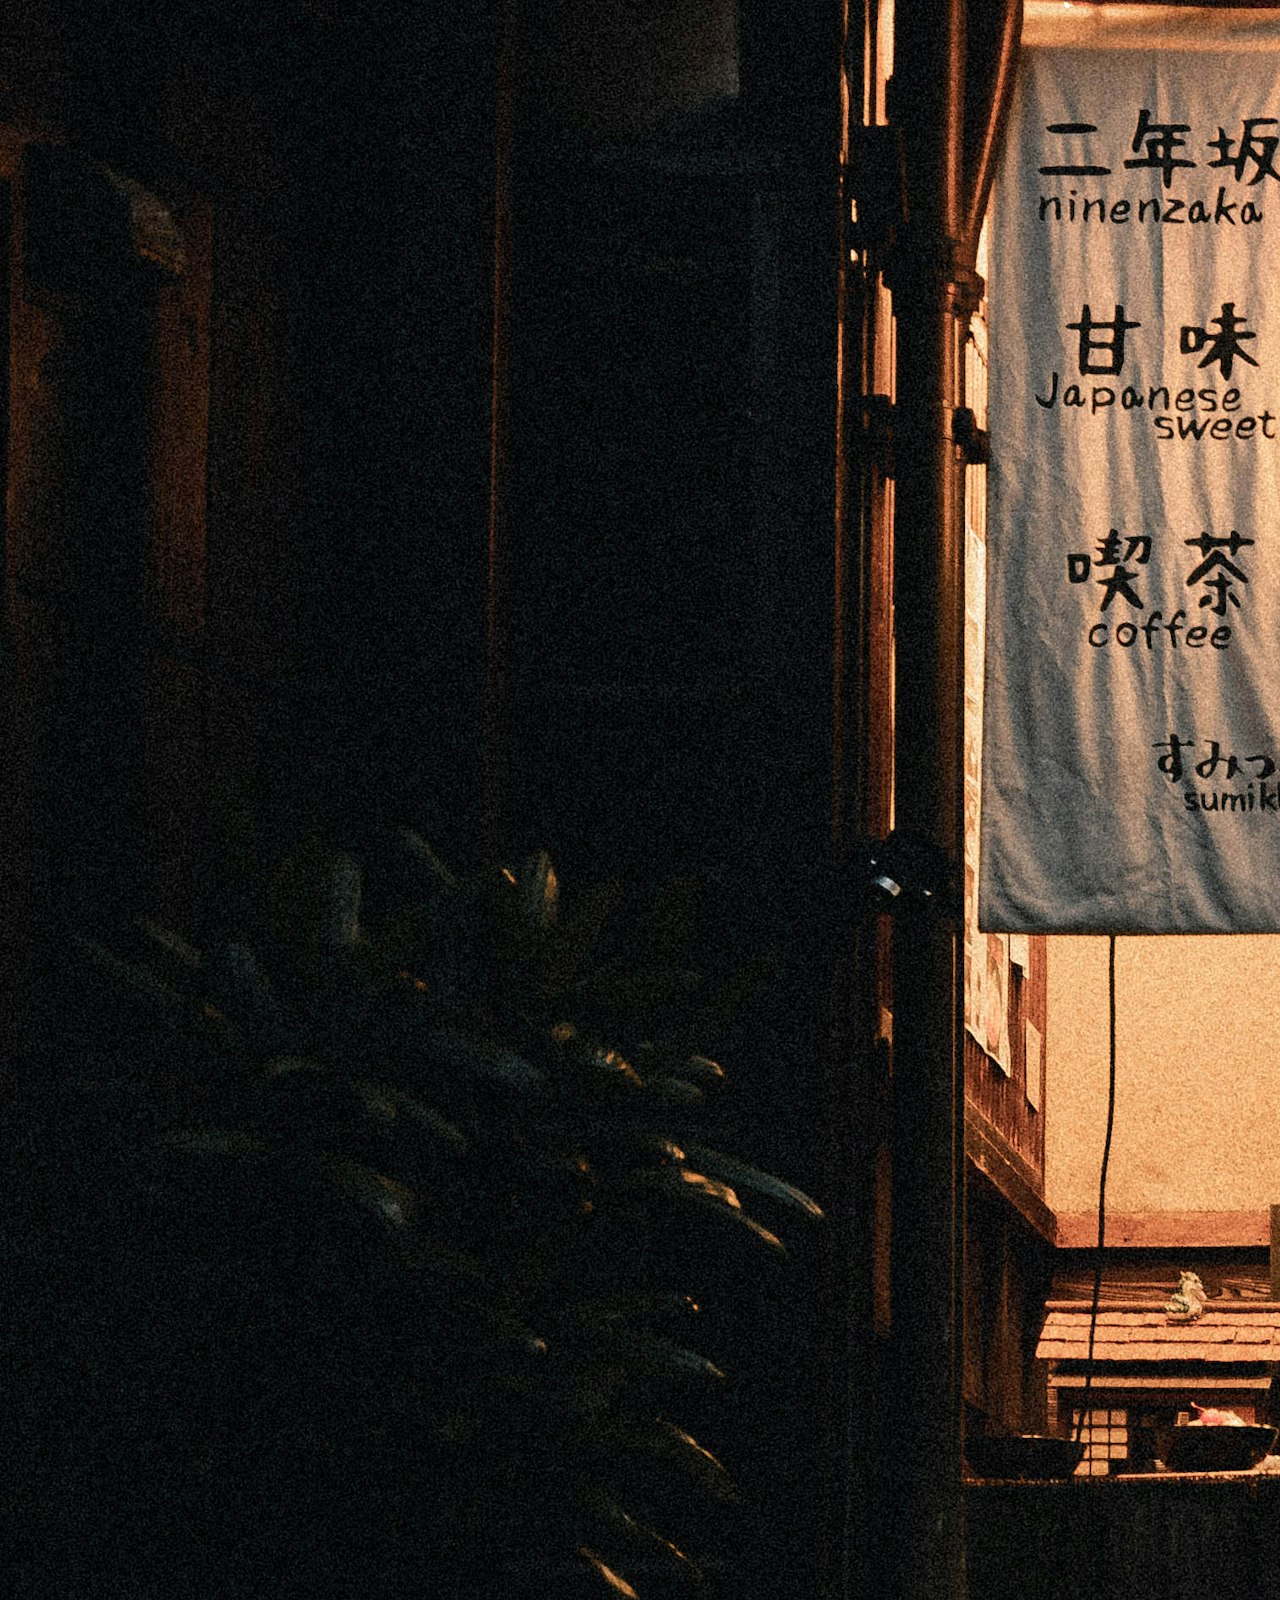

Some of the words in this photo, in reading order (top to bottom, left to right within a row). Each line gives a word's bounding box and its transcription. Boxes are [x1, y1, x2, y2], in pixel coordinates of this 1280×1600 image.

[1039, 189, 1263, 226] ninenzaka
[1066, 302, 1260, 381] 甘味
[1035, 372, 1242, 414] Japanese
[1067, 528, 1255, 617] 喫茶
[1089, 610, 1232, 650] coffee
